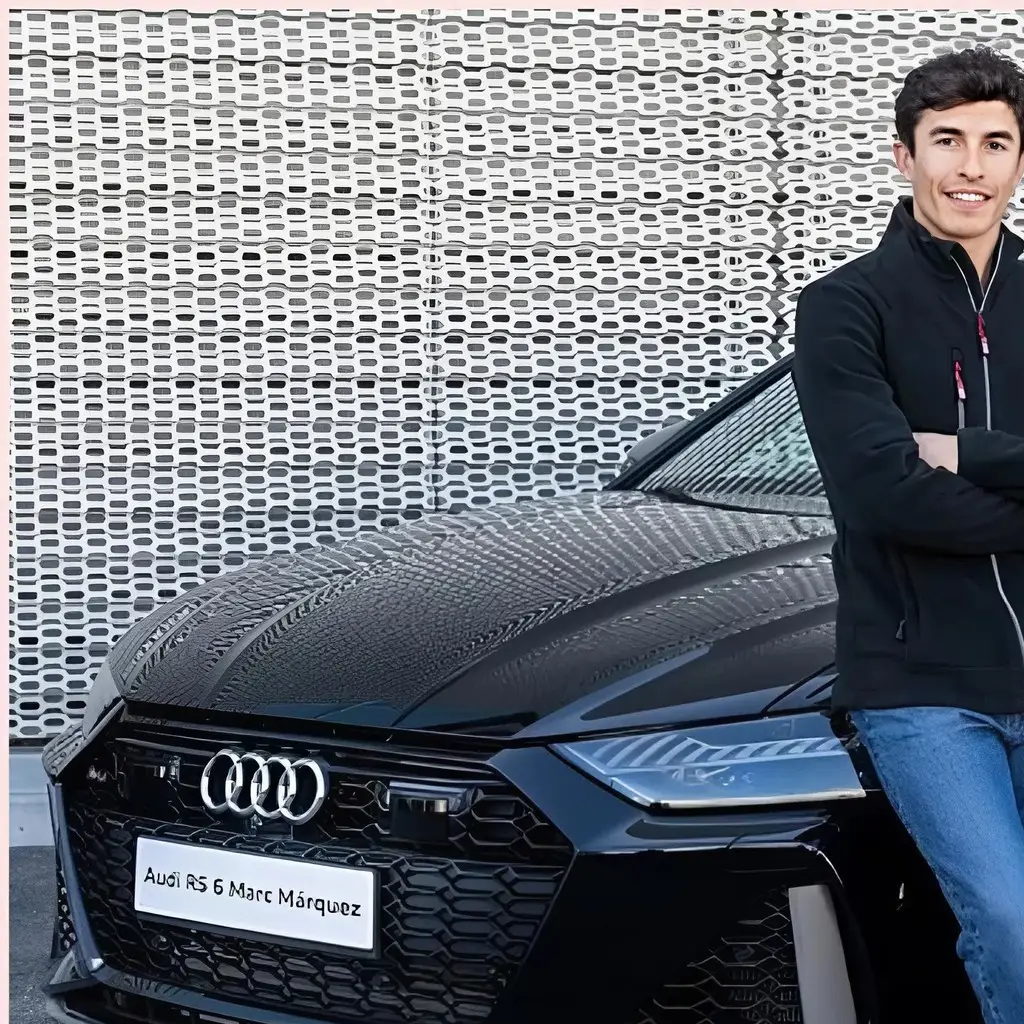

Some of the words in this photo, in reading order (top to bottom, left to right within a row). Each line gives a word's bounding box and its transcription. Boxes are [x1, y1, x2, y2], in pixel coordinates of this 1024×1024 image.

[213, 878, 224, 895] 6
[229, 881, 273, 904] Marc
[279, 888, 362, 918] Márquez
